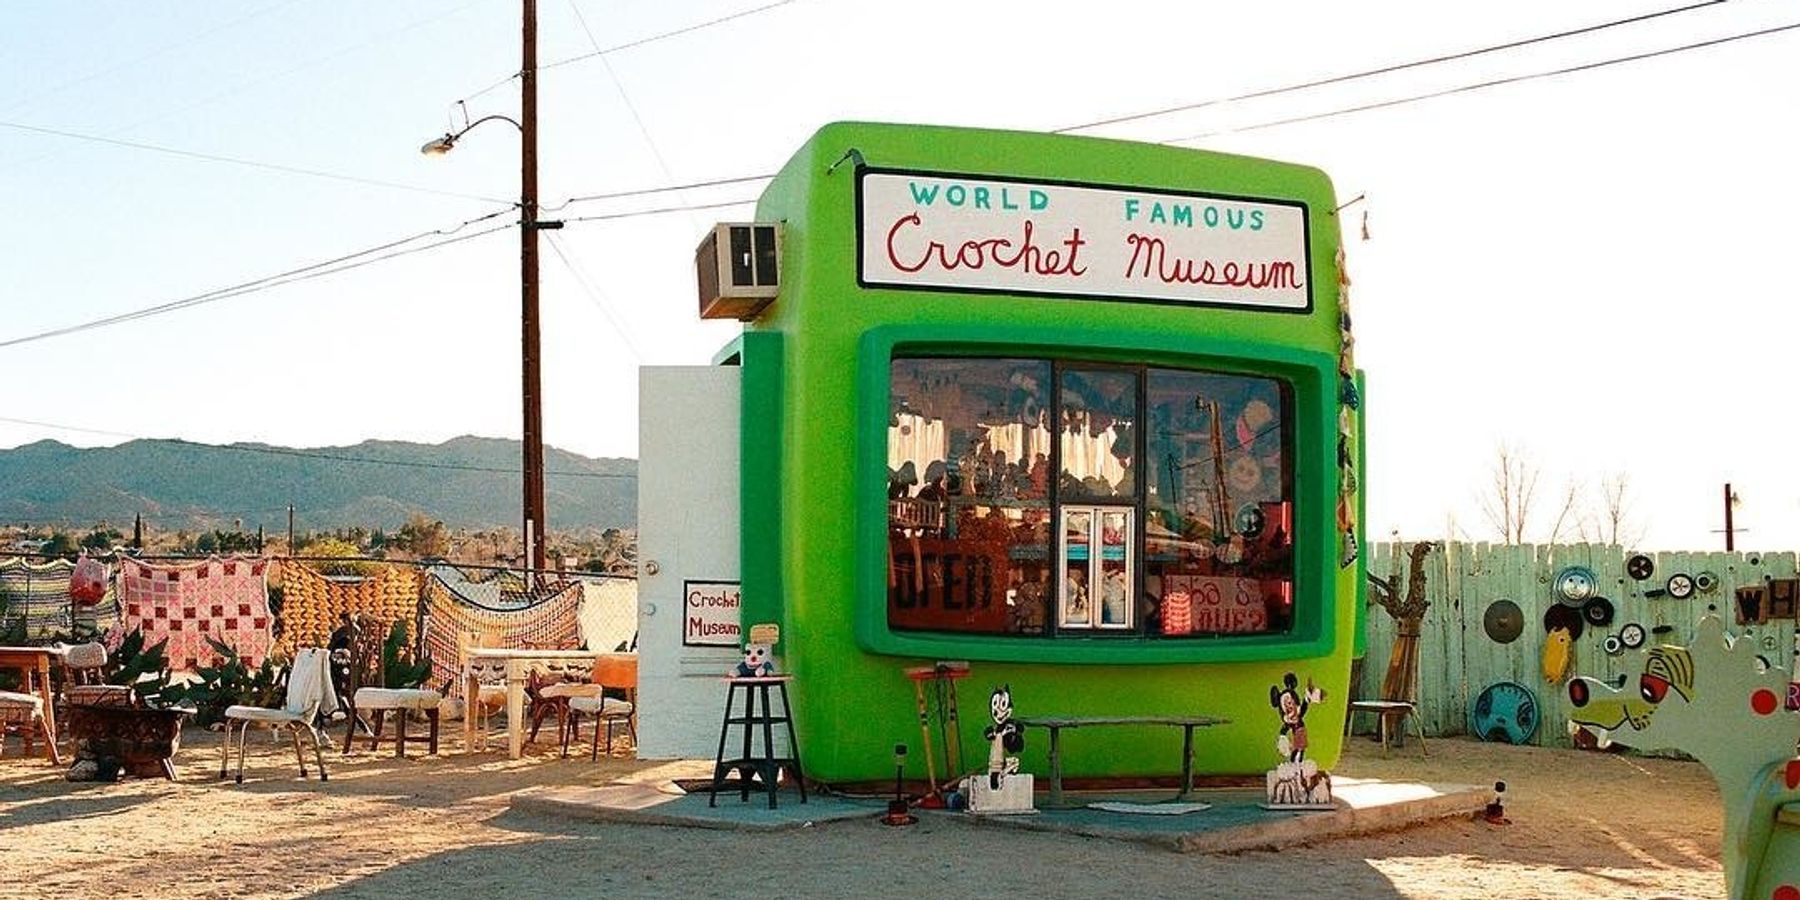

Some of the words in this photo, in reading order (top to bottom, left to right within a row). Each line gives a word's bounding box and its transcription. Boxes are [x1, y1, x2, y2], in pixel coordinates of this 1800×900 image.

[909, 181, 1050, 212] WORLD
[1125, 200, 1265, 231] FAMOUS
[886, 212, 1089, 277] Crochet
[1125, 233, 1303, 290] Museum
[690, 590, 740, 608] Crochet
[690, 617, 741, 636] Museum
